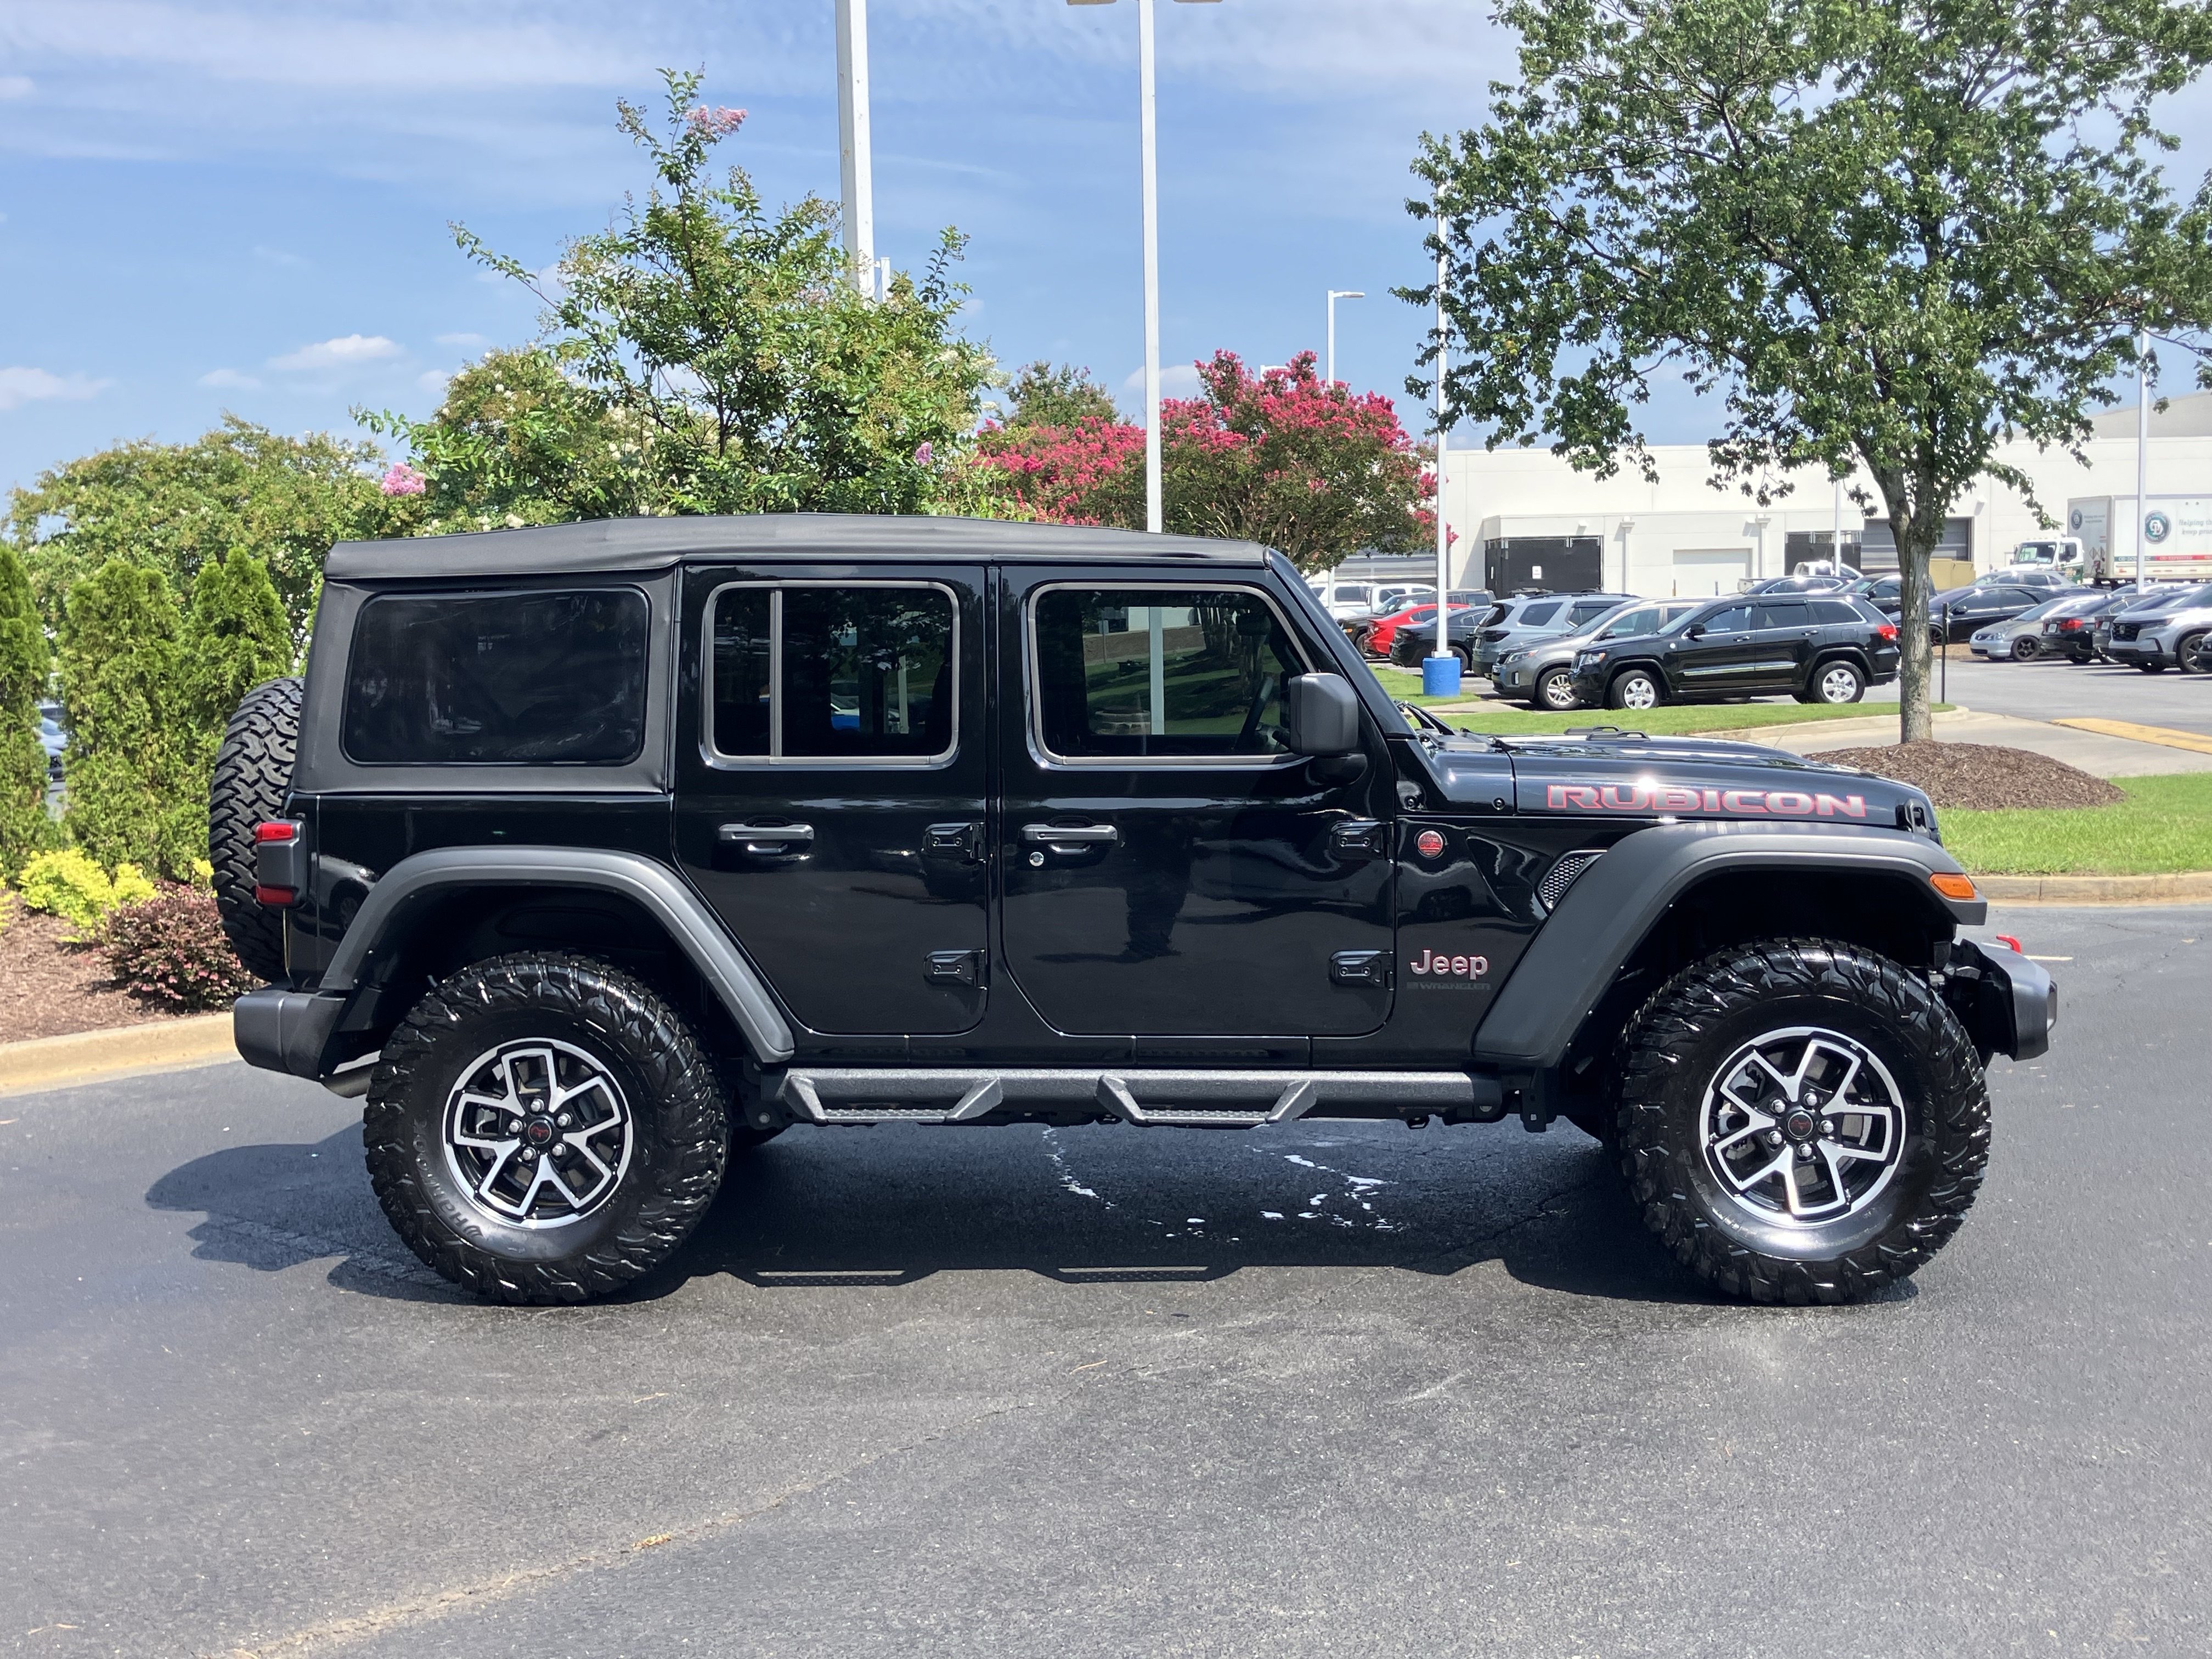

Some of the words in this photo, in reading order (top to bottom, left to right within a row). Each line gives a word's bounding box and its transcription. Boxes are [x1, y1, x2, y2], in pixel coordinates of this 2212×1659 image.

[1547, 785, 1866, 817] RUBICON
[1410, 950, 1488, 980] Jeep
[1419, 981, 1491, 990] WRANGLER
